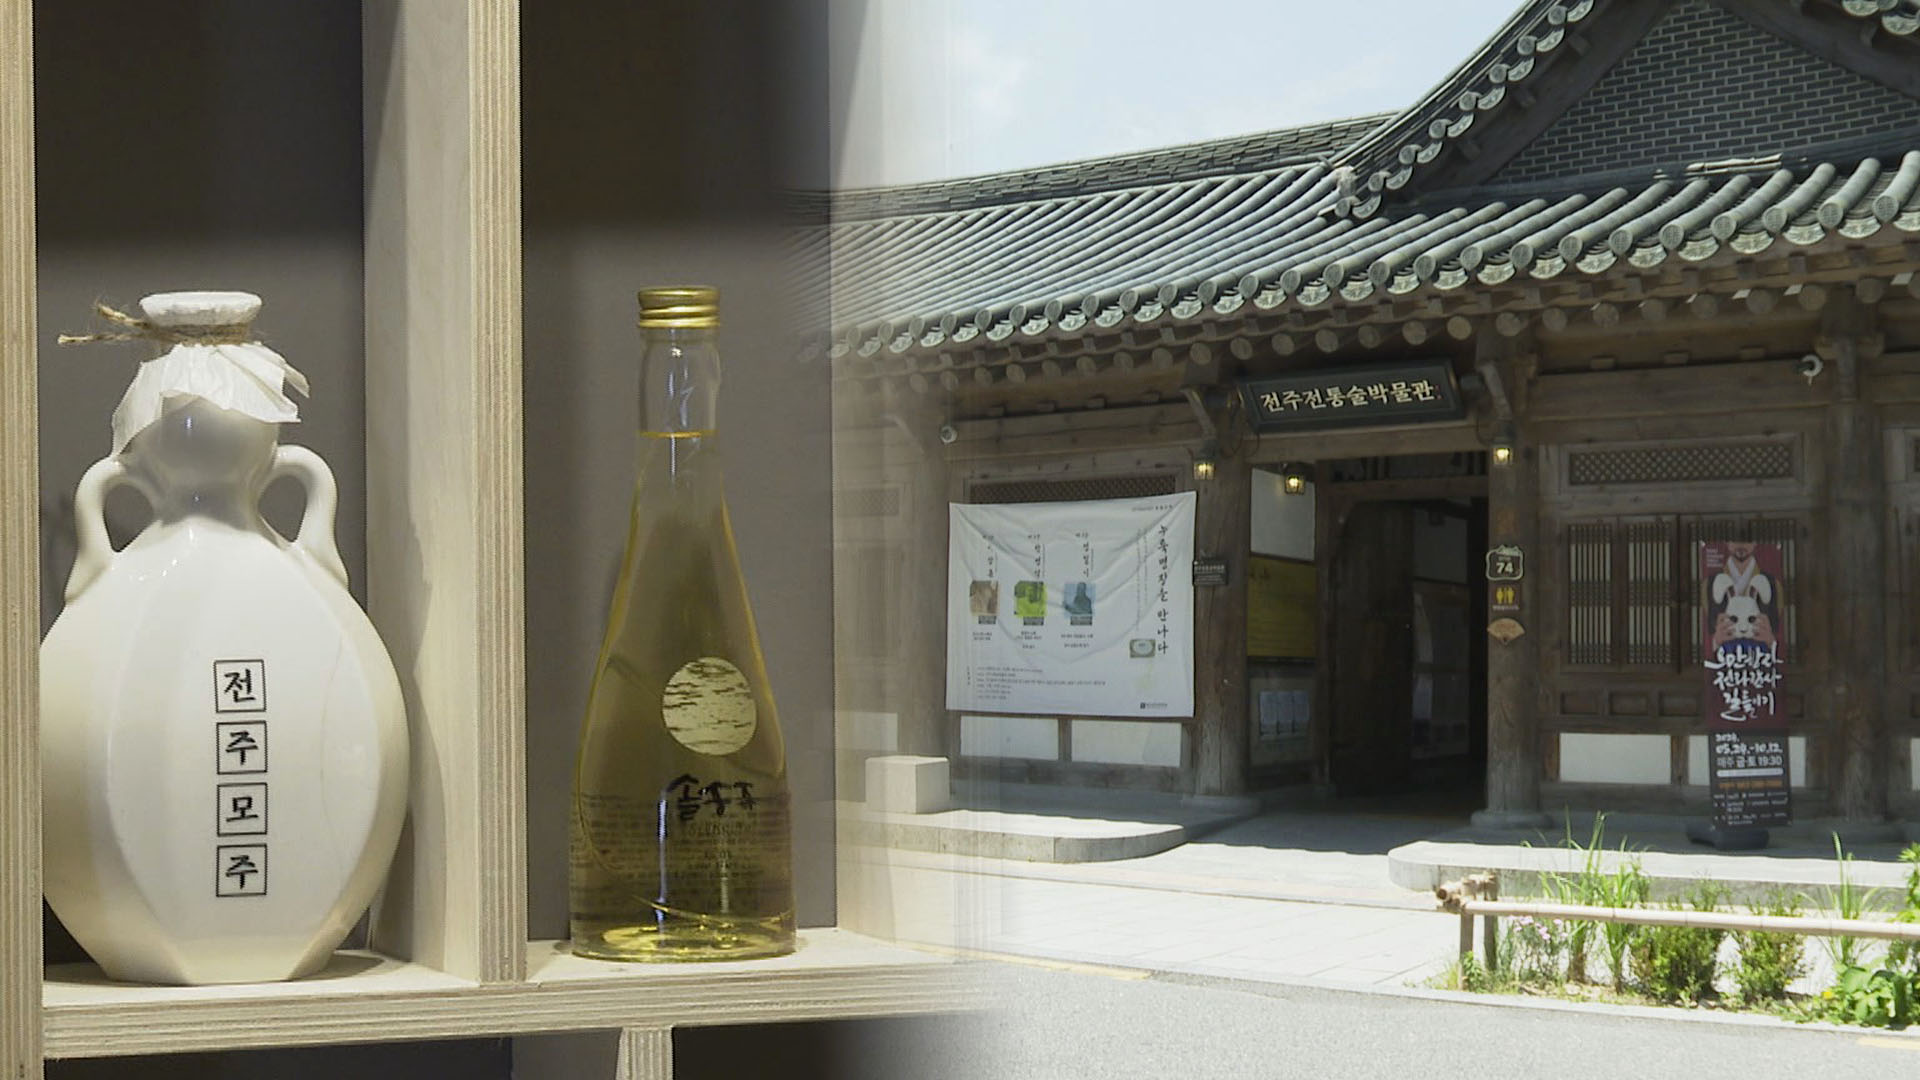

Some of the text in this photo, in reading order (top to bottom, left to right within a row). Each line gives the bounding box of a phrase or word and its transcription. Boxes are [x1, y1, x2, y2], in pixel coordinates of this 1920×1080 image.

[1260, 379, 1436, 413] 전주전통술박물관
[1496, 562, 1513, 574] 74
[1157, 608, 1169, 655] 만나다
[1720, 687, 1777, 722] 길들이기
